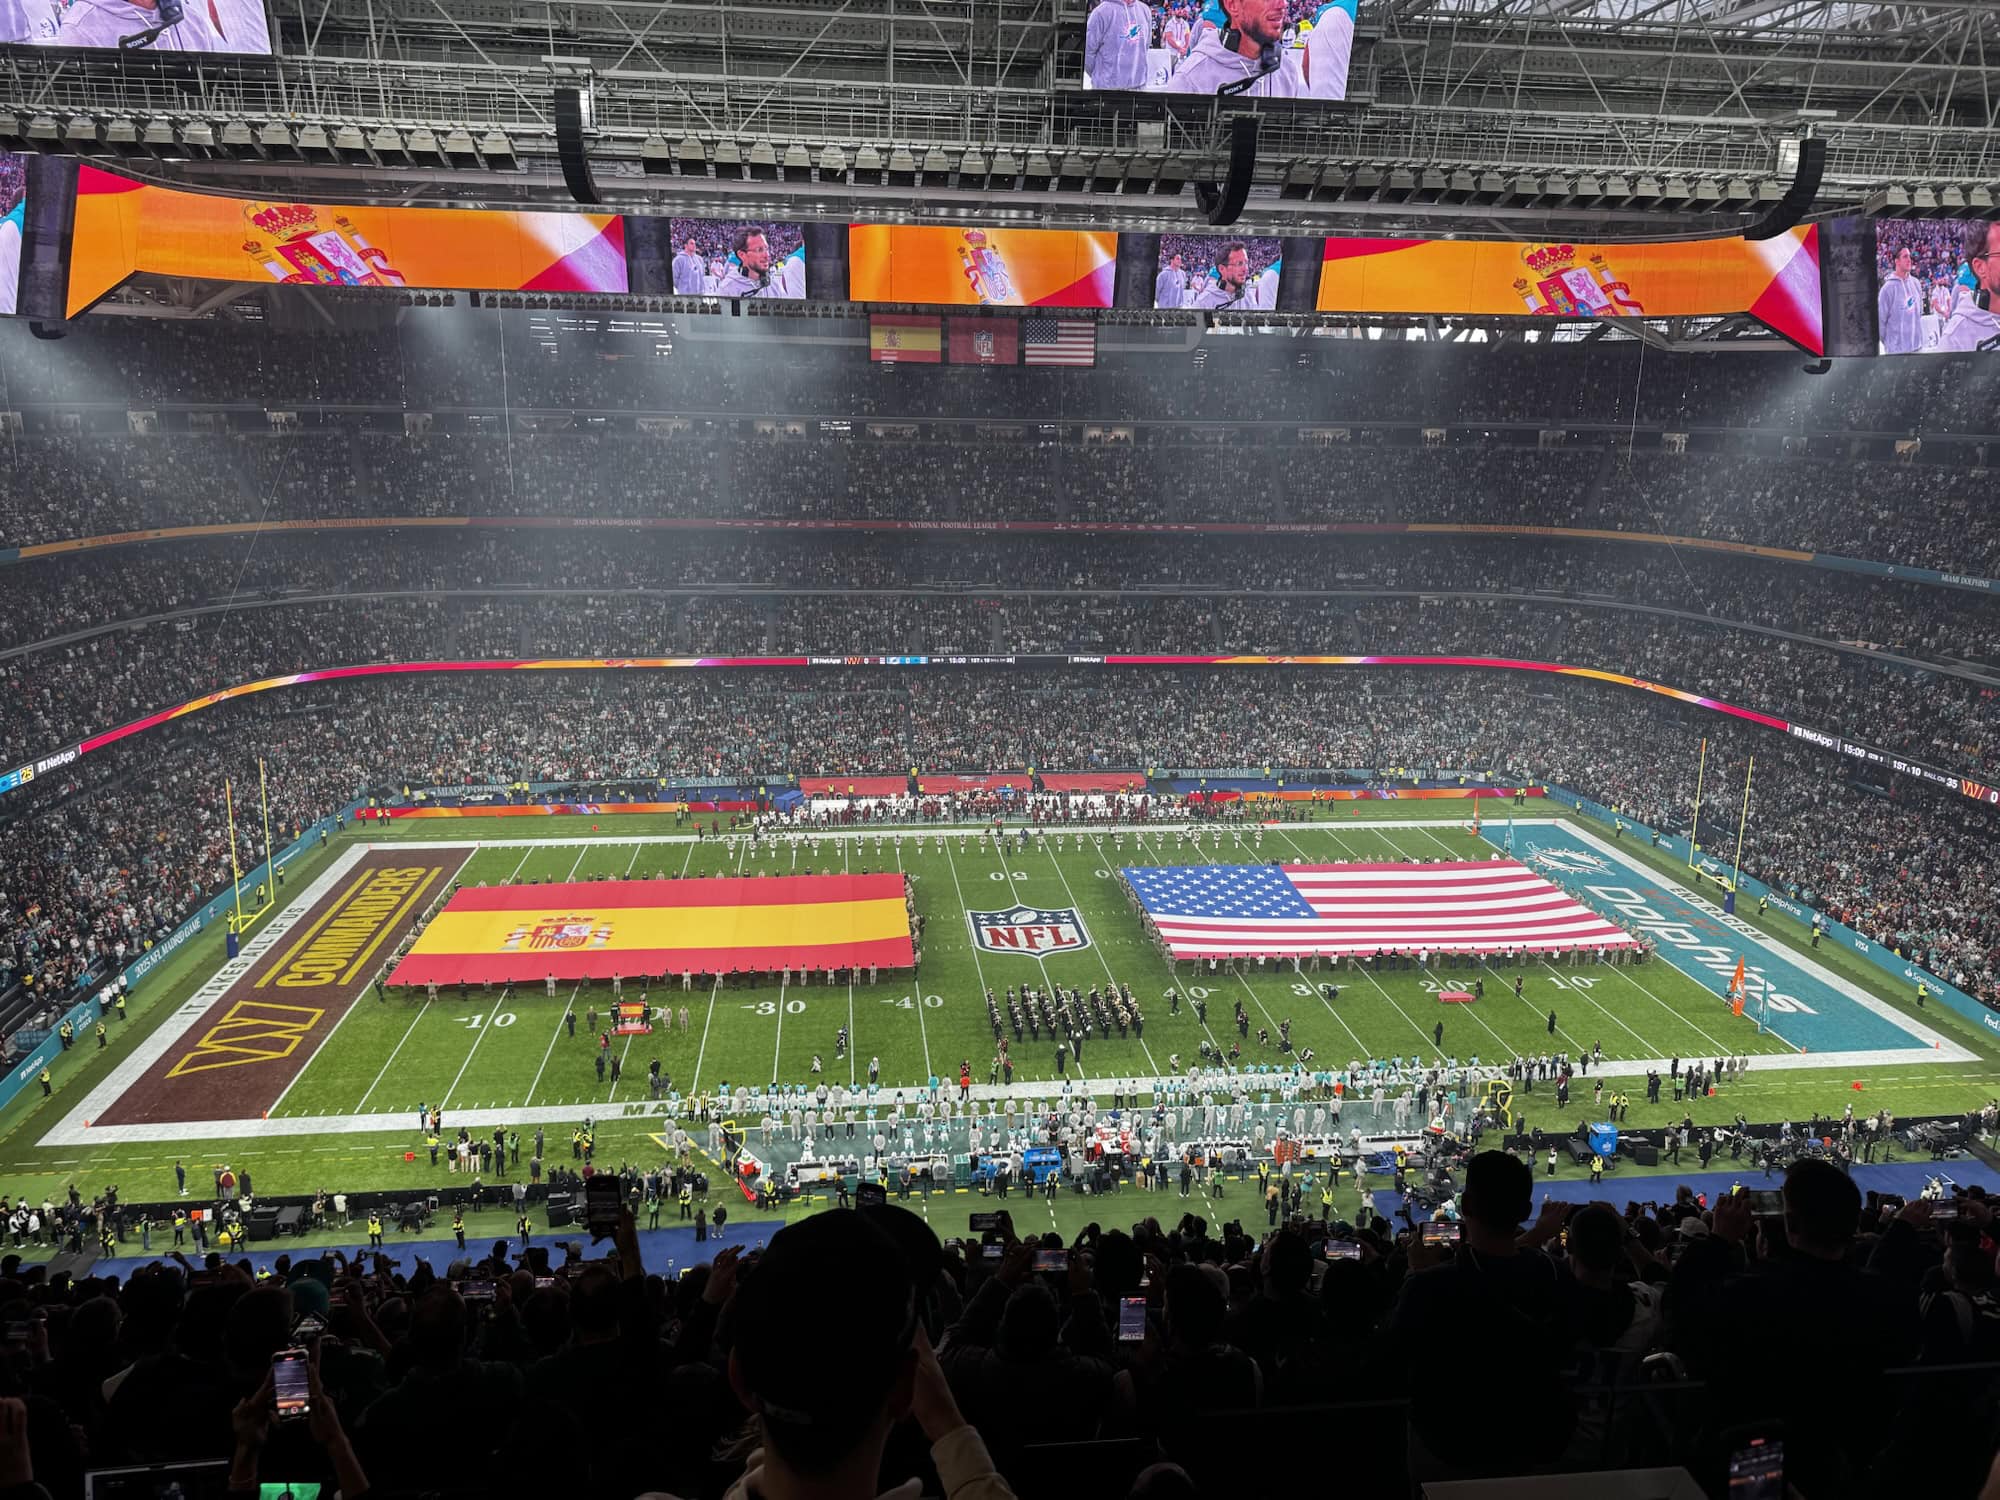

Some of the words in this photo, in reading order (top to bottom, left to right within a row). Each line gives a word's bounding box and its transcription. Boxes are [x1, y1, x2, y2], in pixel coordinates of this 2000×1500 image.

[126, 36, 148, 49] SONY
[1223, 84, 1243, 96] SONY
[908, 521, 939, 529] NATIONAL
[941, 521, 971, 529] FOOTBALL
[1802, 729, 1833, 747] NetApp
[46, 750, 76, 769] NetApp
[1843, 743, 1866, 758] 15:00
[1893, 760, 1907, 772] 1ST
[1911, 766, 1922, 777] 10
[1946, 778, 1959, 789] 35
[1990, 791, 1998, 804] 0
[1670, 887, 1704, 904] END
[1702, 906, 1770, 941] RACISM
[1767, 893, 1803, 917] Dolphins
[276, 867, 426, 987] COMMANDERS
[985, 926, 1077, 950] NFL
[1854, 939, 1870, 953] VISA
[134, 957, 151, 979] 2025
[161, 930, 185, 956] MADRID
[184, 916, 202, 938] GAME
[1584, 885, 1820, 1015] Dolphins
[178, 1004, 206, 1016] IT
[197, 962, 249, 998] TAKES
[241, 940, 273, 958] ALL
[264, 923, 289, 936] OF
[279, 907, 306, 920] US
[1418, 979, 1468, 993] 20
[1547, 975, 1595, 990] 10
[1912, 972, 1945, 996] Santander
[755, 1000, 807, 1016] 30
[895, 995, 944, 1009] 40
[465, 1012, 518, 1030] 10
